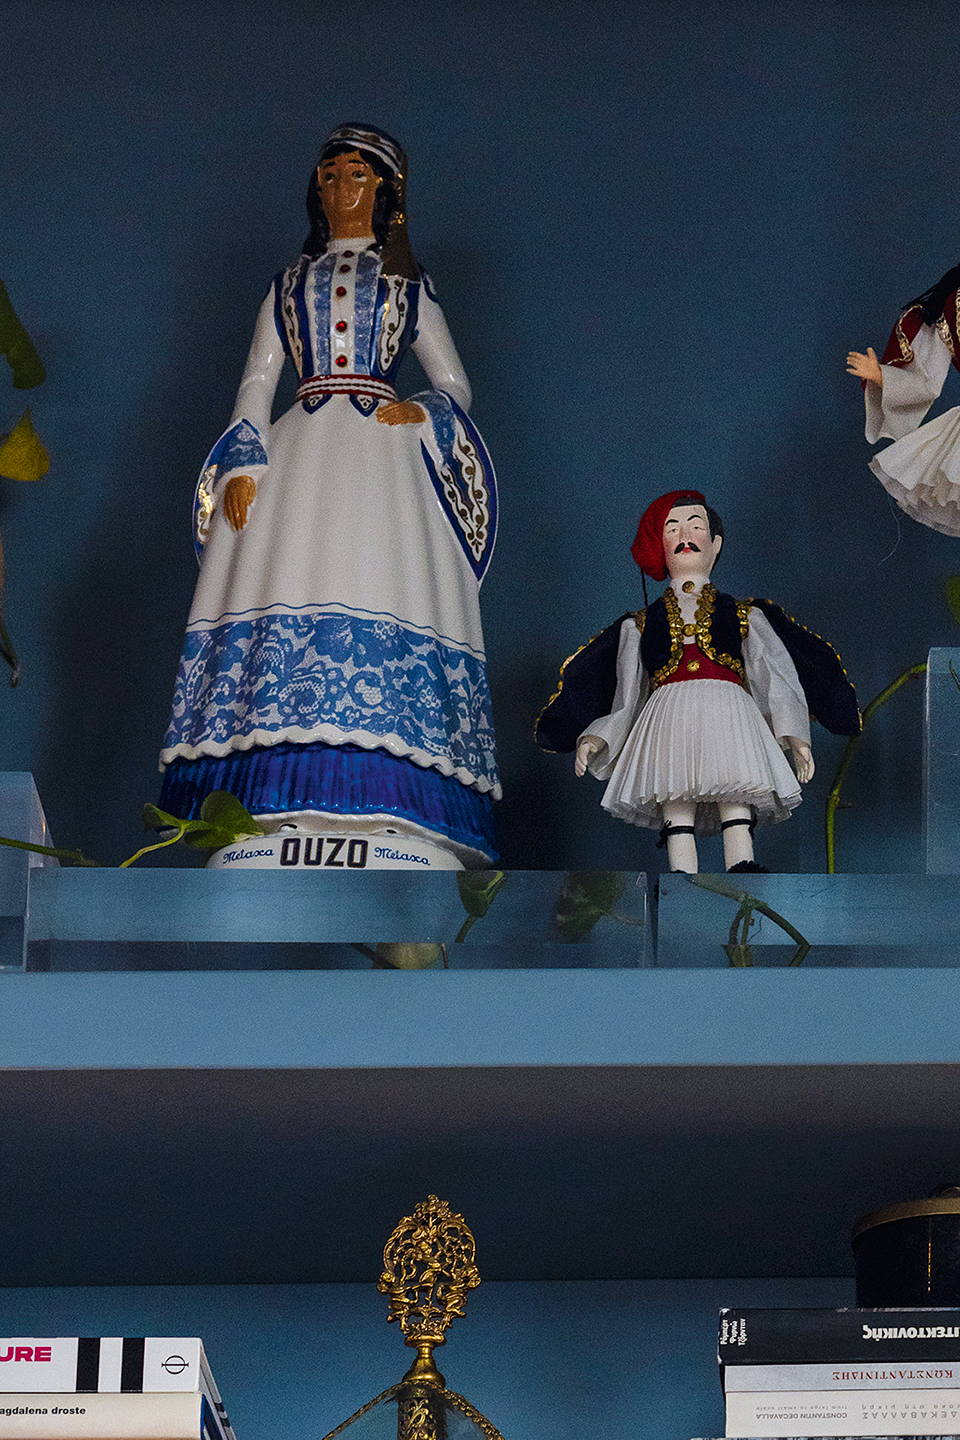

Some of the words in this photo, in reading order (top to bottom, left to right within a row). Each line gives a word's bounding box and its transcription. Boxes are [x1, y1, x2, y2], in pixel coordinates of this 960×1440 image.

[223, 848, 274, 864] Metaxa
[280, 837, 368, 868] OUZO
[374, 847, 431, 865] Metaxa
[832, 1369, 954, 1381] ΚΩΝΣΤΑΝΤΙΝΙΔΗΣ
[51, 1406, 86, 1415] droste
[862, 1411, 957, 1419] ΔΕΚΑΒΑΛΛΑΣ
